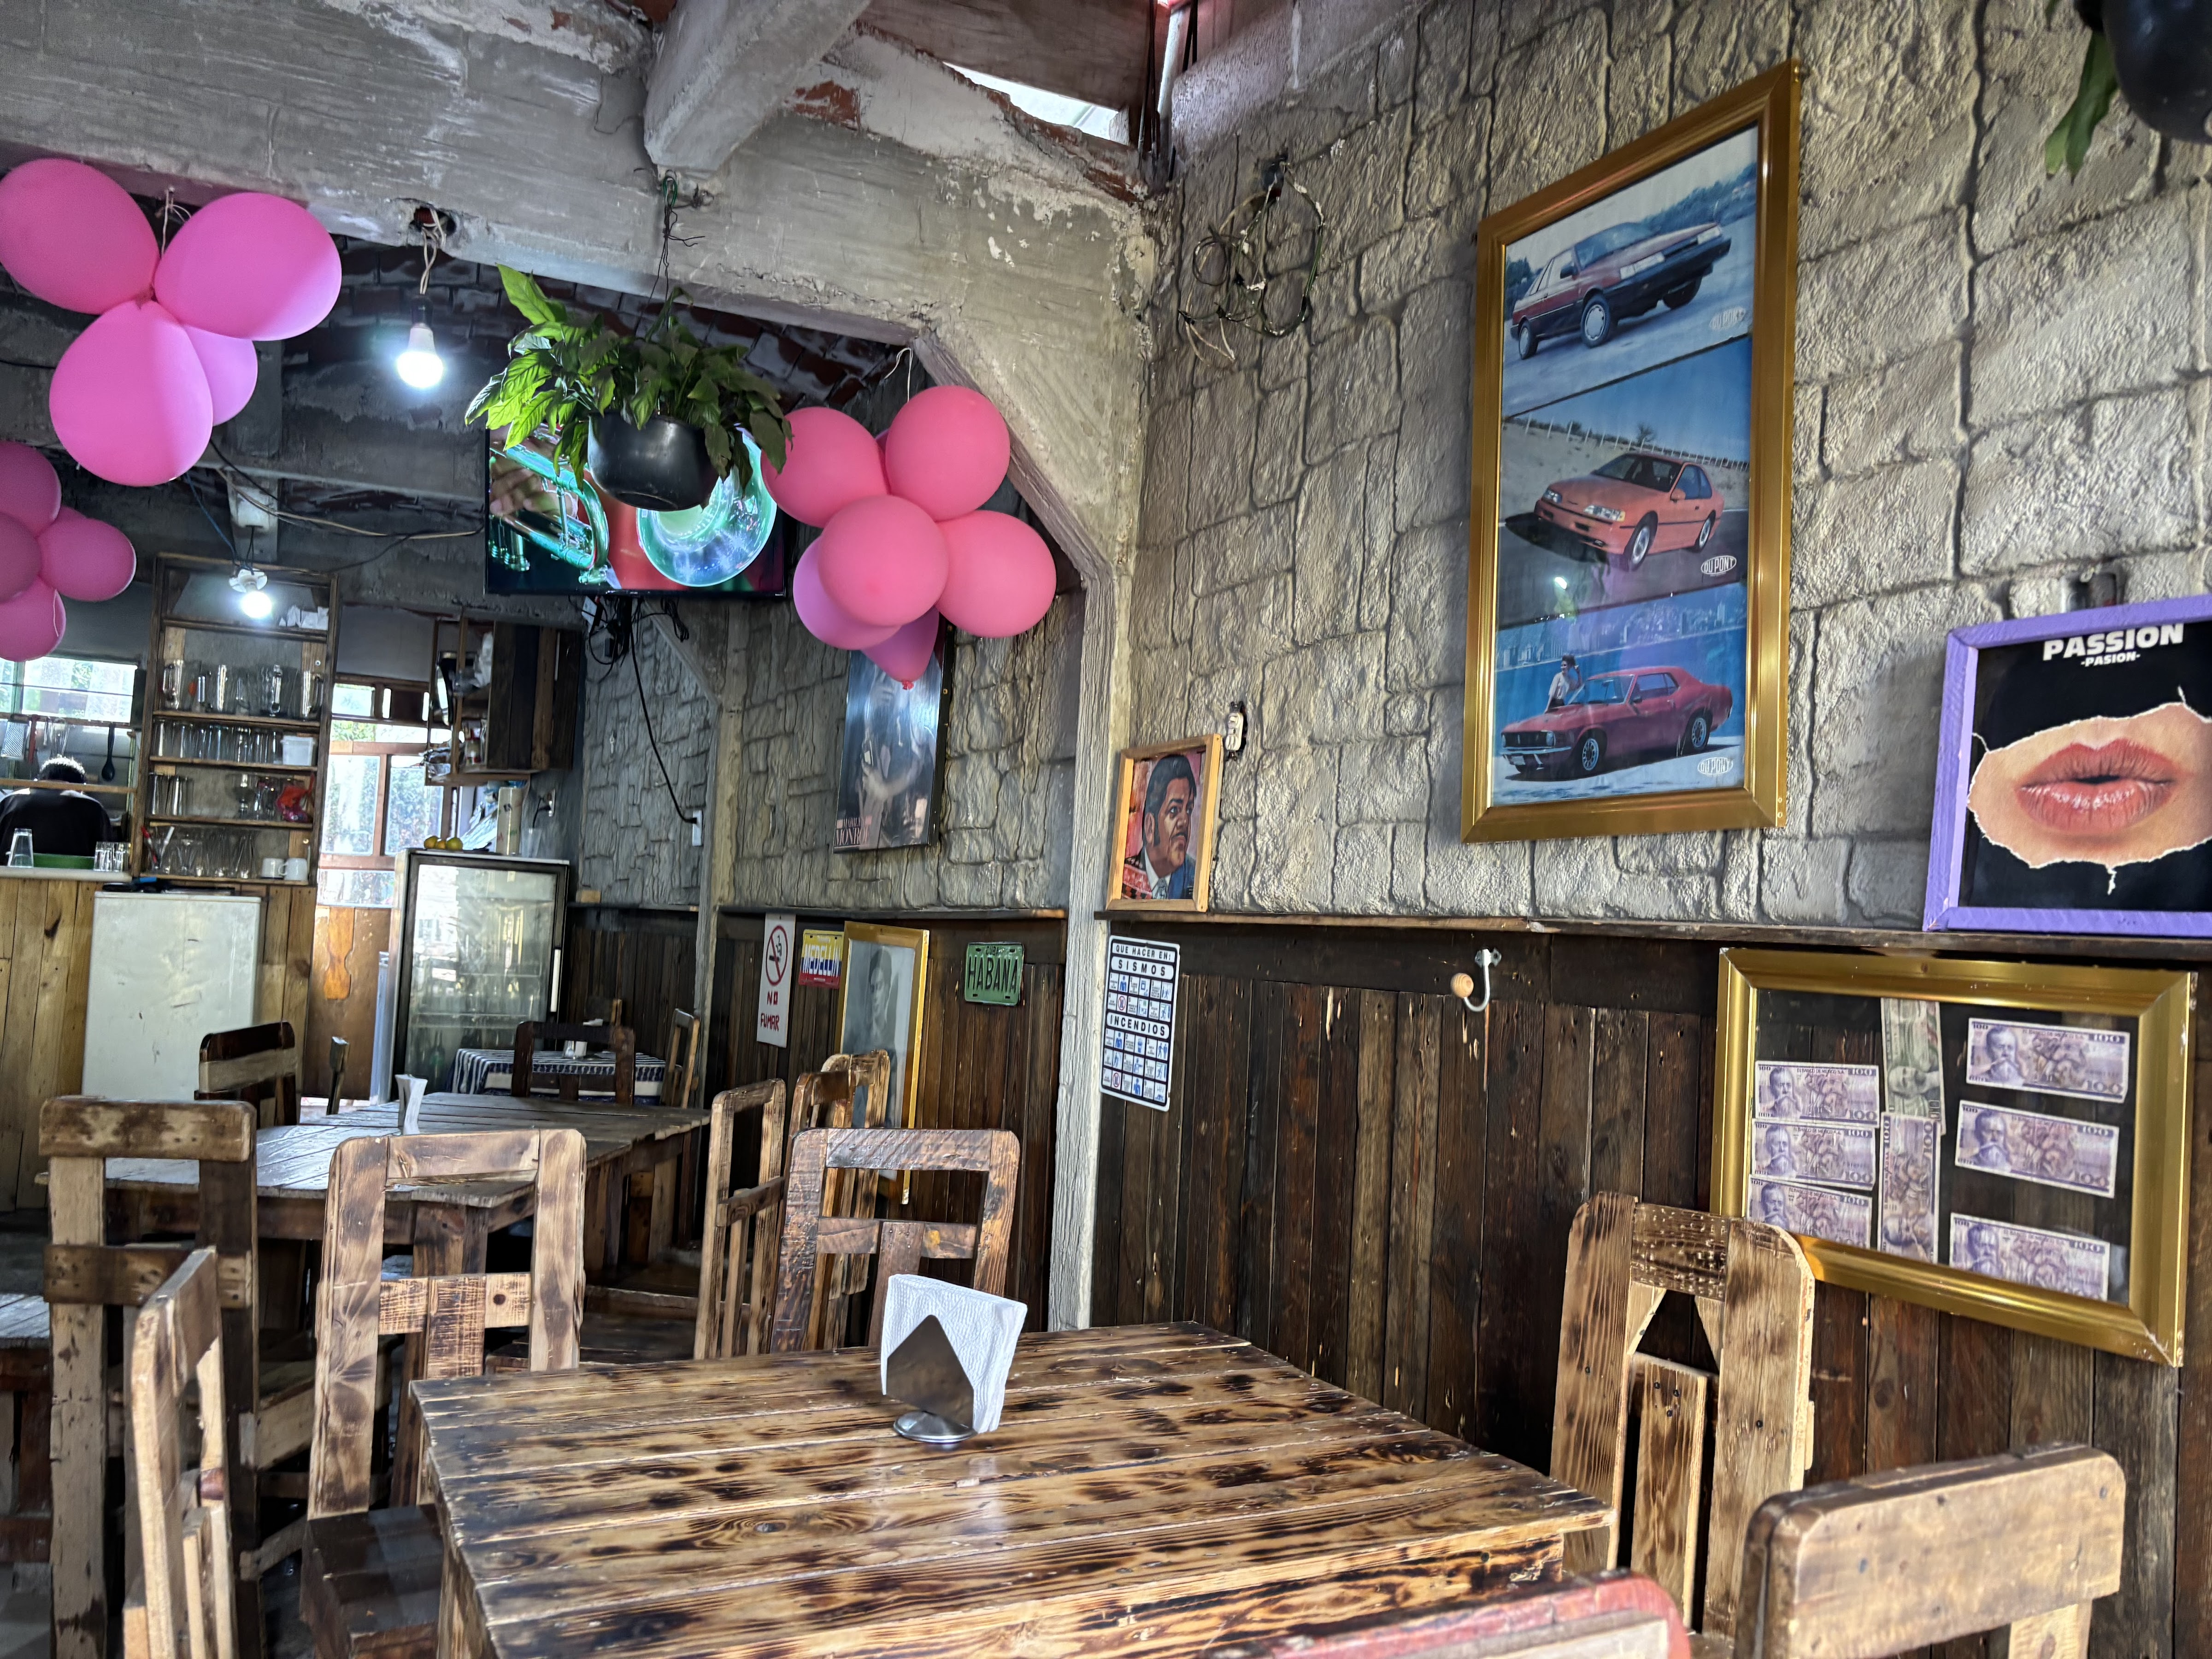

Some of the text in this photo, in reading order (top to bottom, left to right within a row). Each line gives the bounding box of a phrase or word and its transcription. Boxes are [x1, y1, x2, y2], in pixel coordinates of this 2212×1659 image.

[1704, 557, 1734, 573] DU PONT
[2043, 623, 2184, 661] PASSION
[1700, 759, 1709, 773] DU
[986, 946, 999, 956] CUBA
[1116, 944, 1171, 960] QUE HACER EN:
[1118, 959, 1165, 976] SISMOS
[968, 956, 1018, 994] HABANA
[767, 991, 778, 1005] NO
[760, 1013, 780, 1032] FUMAR
[1110, 1015, 1165, 1036] INCENDIOS
[2094, 1034, 2120, 1043] 100
[2087, 1081, 2123, 1094] 100
[1849, 1110, 1877, 1121] 100
[1924, 1121, 1933, 1154] 100
[2083, 1127, 2109, 1136] 100
[1845, 1172, 1873, 1183] 100
[1843, 1196, 1865, 1206] 100
